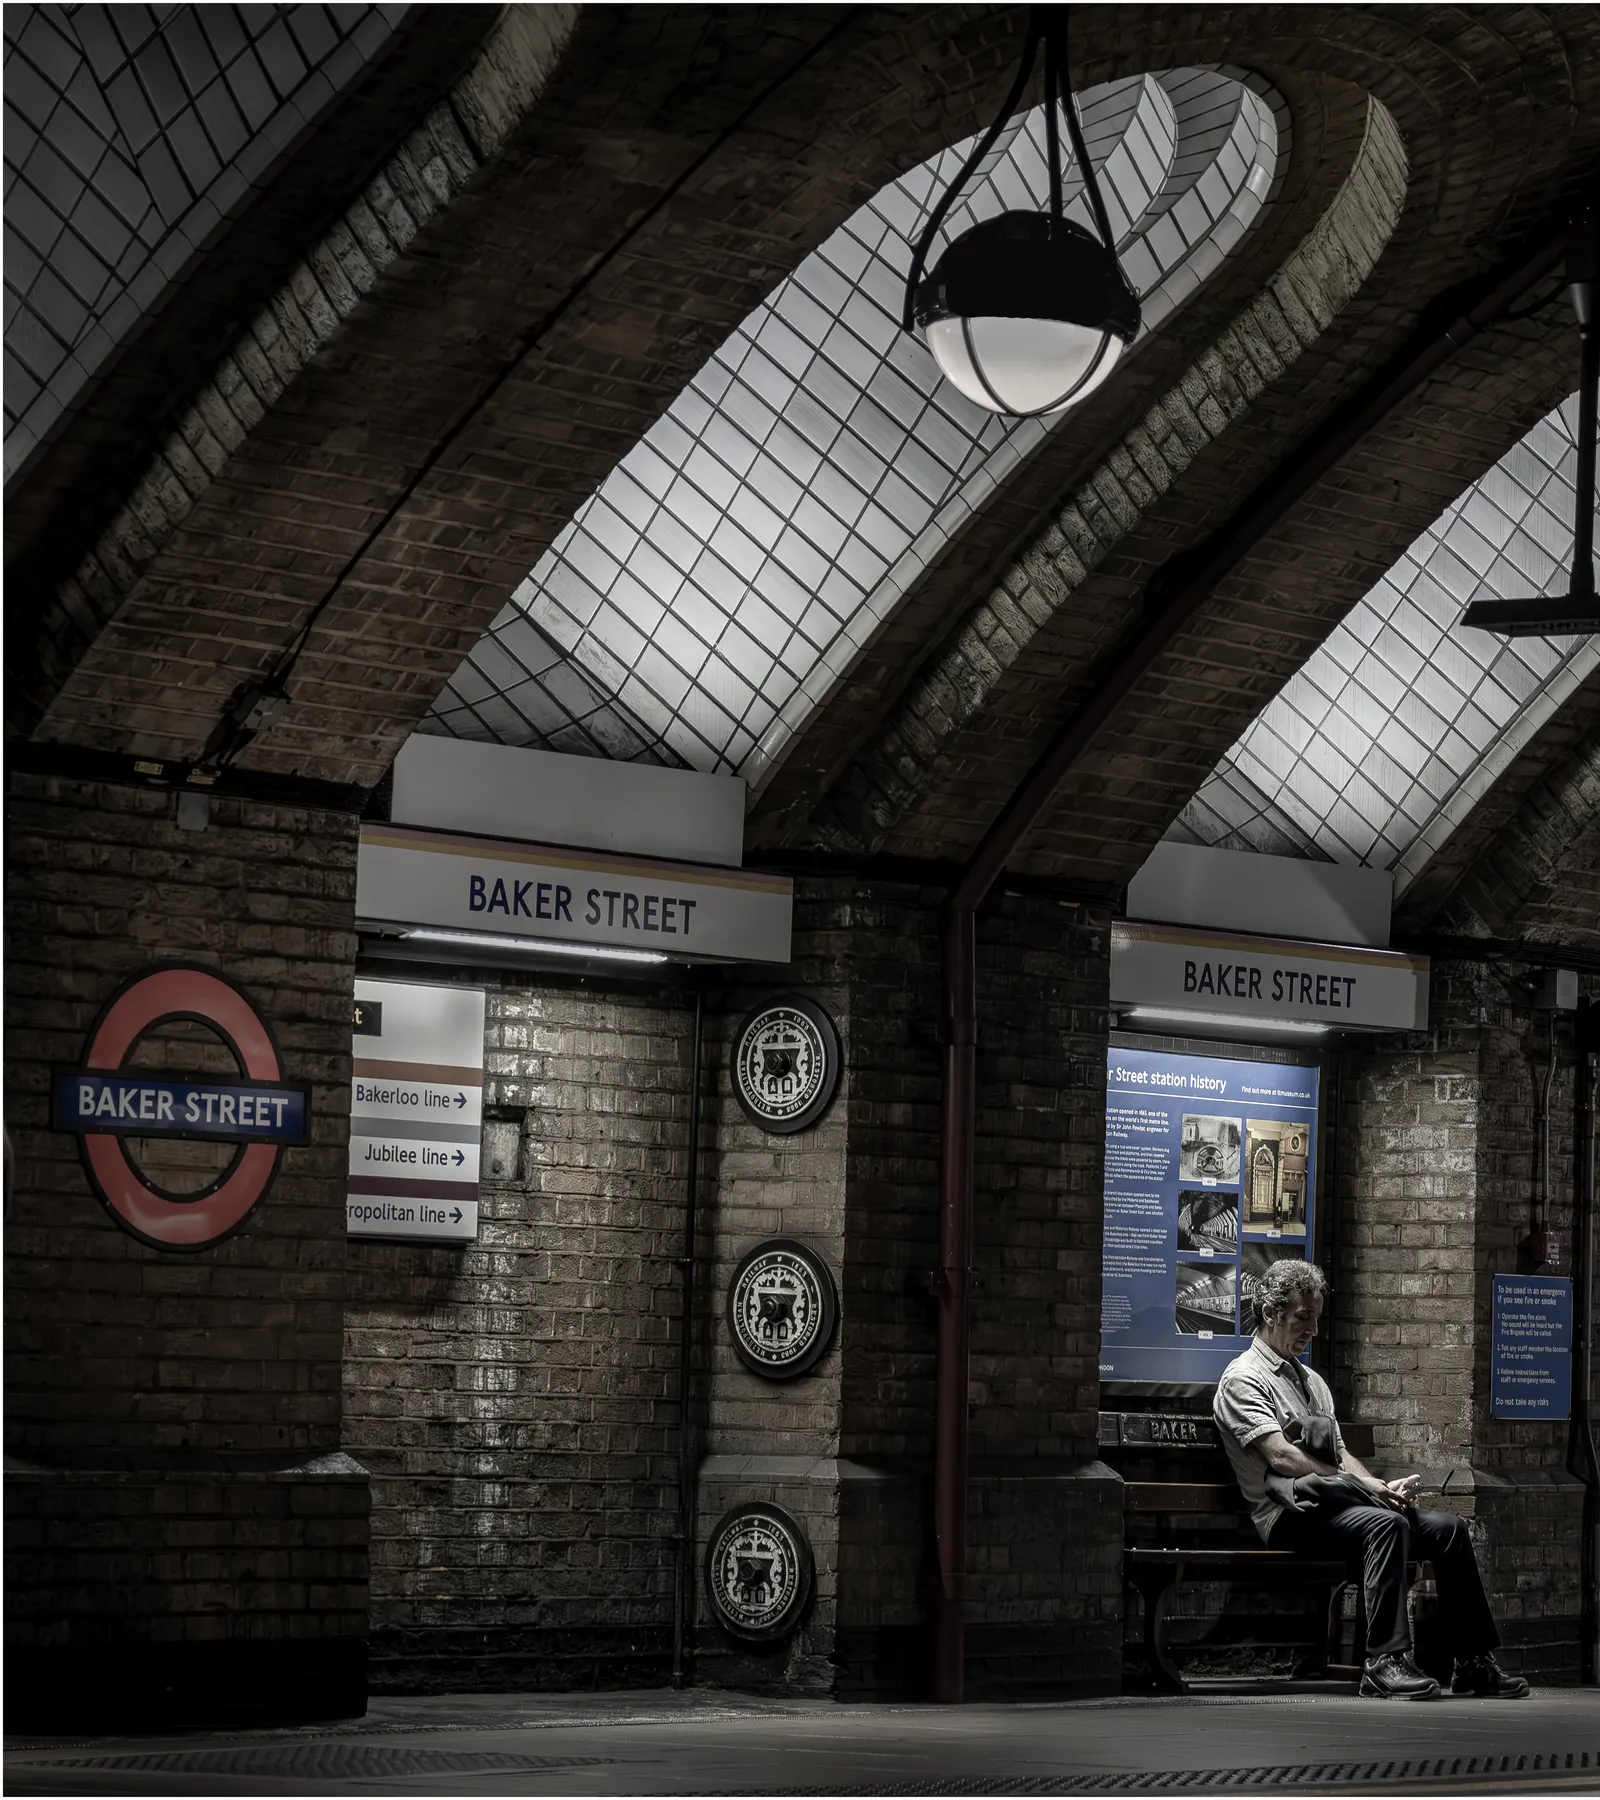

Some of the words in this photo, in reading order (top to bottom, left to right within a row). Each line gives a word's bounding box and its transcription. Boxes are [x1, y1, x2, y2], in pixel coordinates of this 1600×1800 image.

[469, 874, 574, 922] BAKER
[584, 887, 697, 935] STREET
[1184, 960, 1262, 999] BAKER
[1271, 969, 1356, 1008] STREET
[744, 1016, 769, 1047] RAILWAY
[794, 1016, 810, 1031] 1863
[804, 1054, 820, 1099] RESTORED
[740, 1060, 771, 1113] METROPOLITAN
[1116, 1066, 1148, 1084] Street
[1150, 1072, 1186, 1088] station
[1190, 1074, 1226, 1094] history
[79, 1085, 174, 1121] BAKER
[184, 1091, 288, 1128] STREET
[356, 1084, 419, 1106] Bakerloo
[424, 1090, 450, 1108] line
[364, 1144, 417, 1164] Jubilee
[422, 1148, 448, 1166] line
[345, 1202, 414, 1224] ropolitan
[420, 1205, 446, 1224] line
[741, 1260, 768, 1288] RAILWAY
[792, 1261, 808, 1278] 1863
[800, 1303, 817, 1347] RESTORED
[1498, 1285, 1504, 1293] To
[1540, 1289, 1566, 1297] emergency
[1503, 1297, 1513, 1305] you
[1524, 1296, 1534, 1305] fire
[1541, 1297, 1556, 1305] smoke
[737, 1301, 766, 1357] METROPOLITAN
[1150, 1420, 1198, 1440] BAKER
[768, 1524, 784, 1542] 1863
